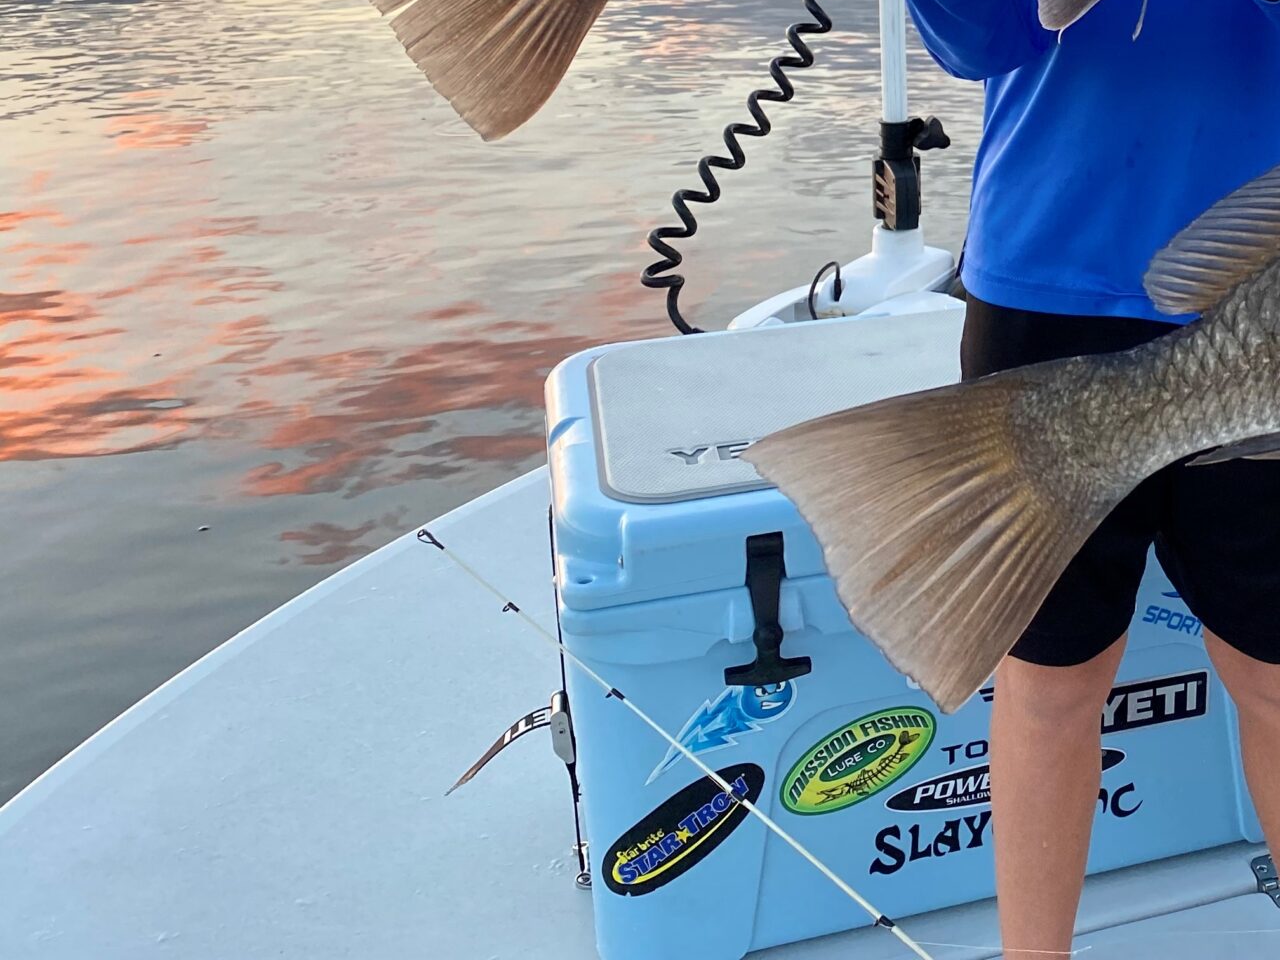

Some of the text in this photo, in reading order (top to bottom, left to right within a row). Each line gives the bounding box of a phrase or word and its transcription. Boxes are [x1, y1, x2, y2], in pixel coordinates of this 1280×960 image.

[1102, 680, 1199, 728] YETI
[788, 714, 930, 806] MISSION FISHIN
[826, 751, 864, 778] LURE
[617, 831, 684, 886] STAR
